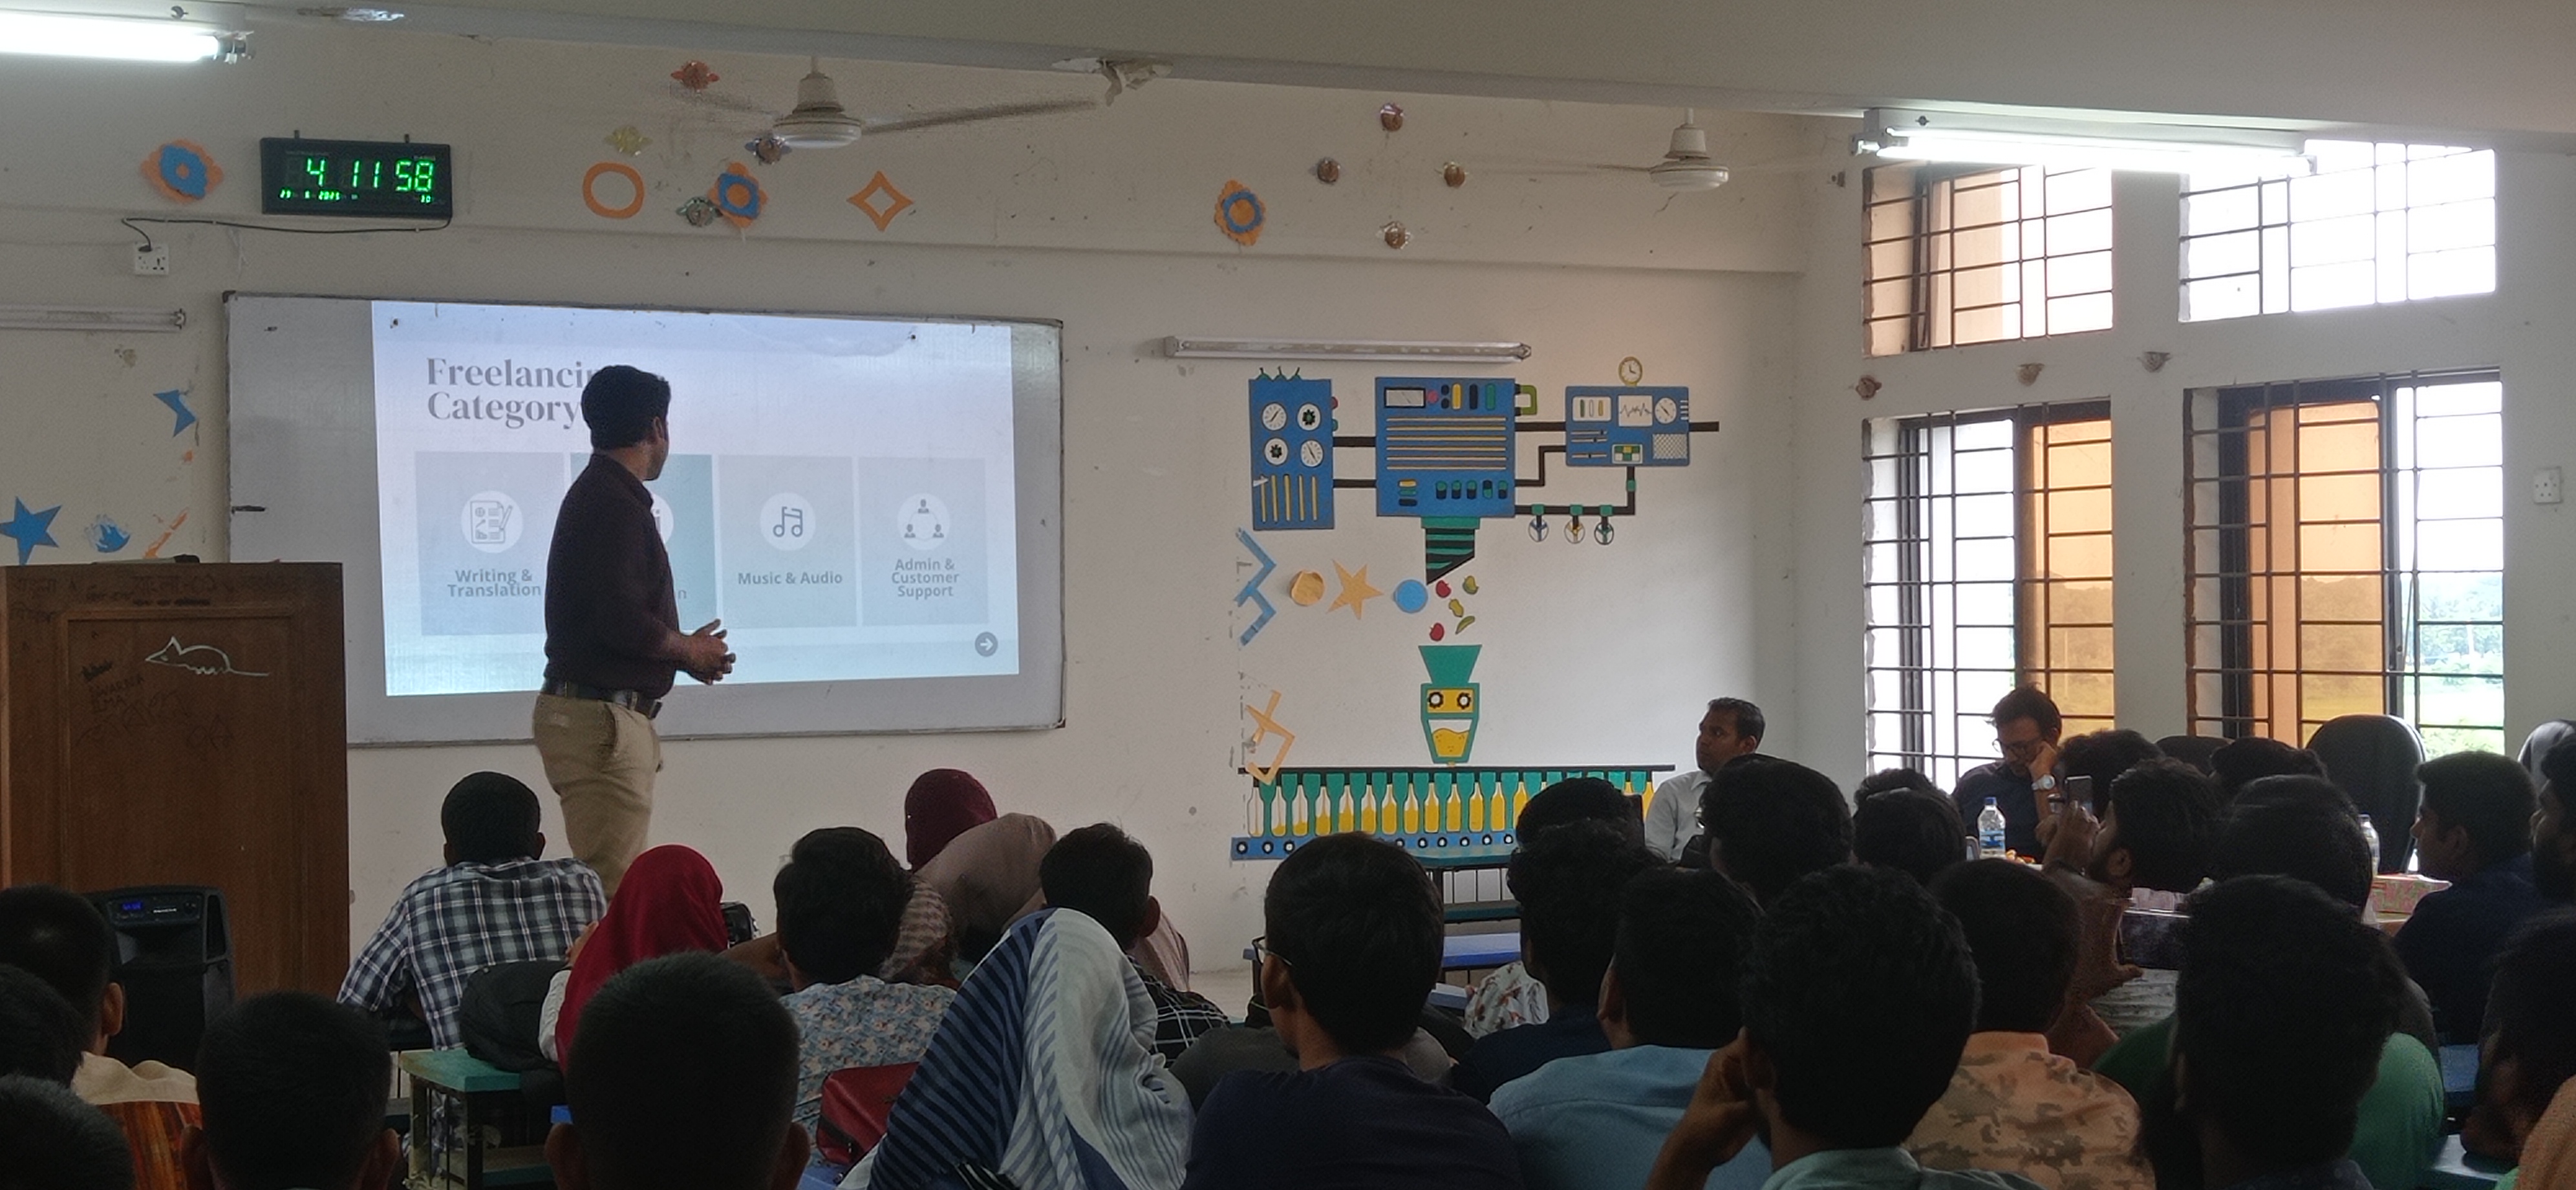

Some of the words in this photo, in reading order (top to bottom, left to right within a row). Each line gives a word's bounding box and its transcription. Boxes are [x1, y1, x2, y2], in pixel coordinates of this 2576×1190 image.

[306, 158, 326, 187] 4
[352, 160, 381, 188] 11
[395, 160, 434, 191] 58
[427, 358, 598, 389] Freelanci
[427, 391, 582, 429] Category
[895, 557, 940, 570] Admin
[944, 557, 955, 570] &
[455, 568, 517, 585] Writing
[521, 568, 533, 581] &
[738, 571, 781, 585] Music
[785, 572, 796, 584] &
[800, 570, 843, 585] Audio
[892, 572, 960, 584] Customer
[447, 583, 541, 598] Translation
[897, 585, 954, 600] Support
